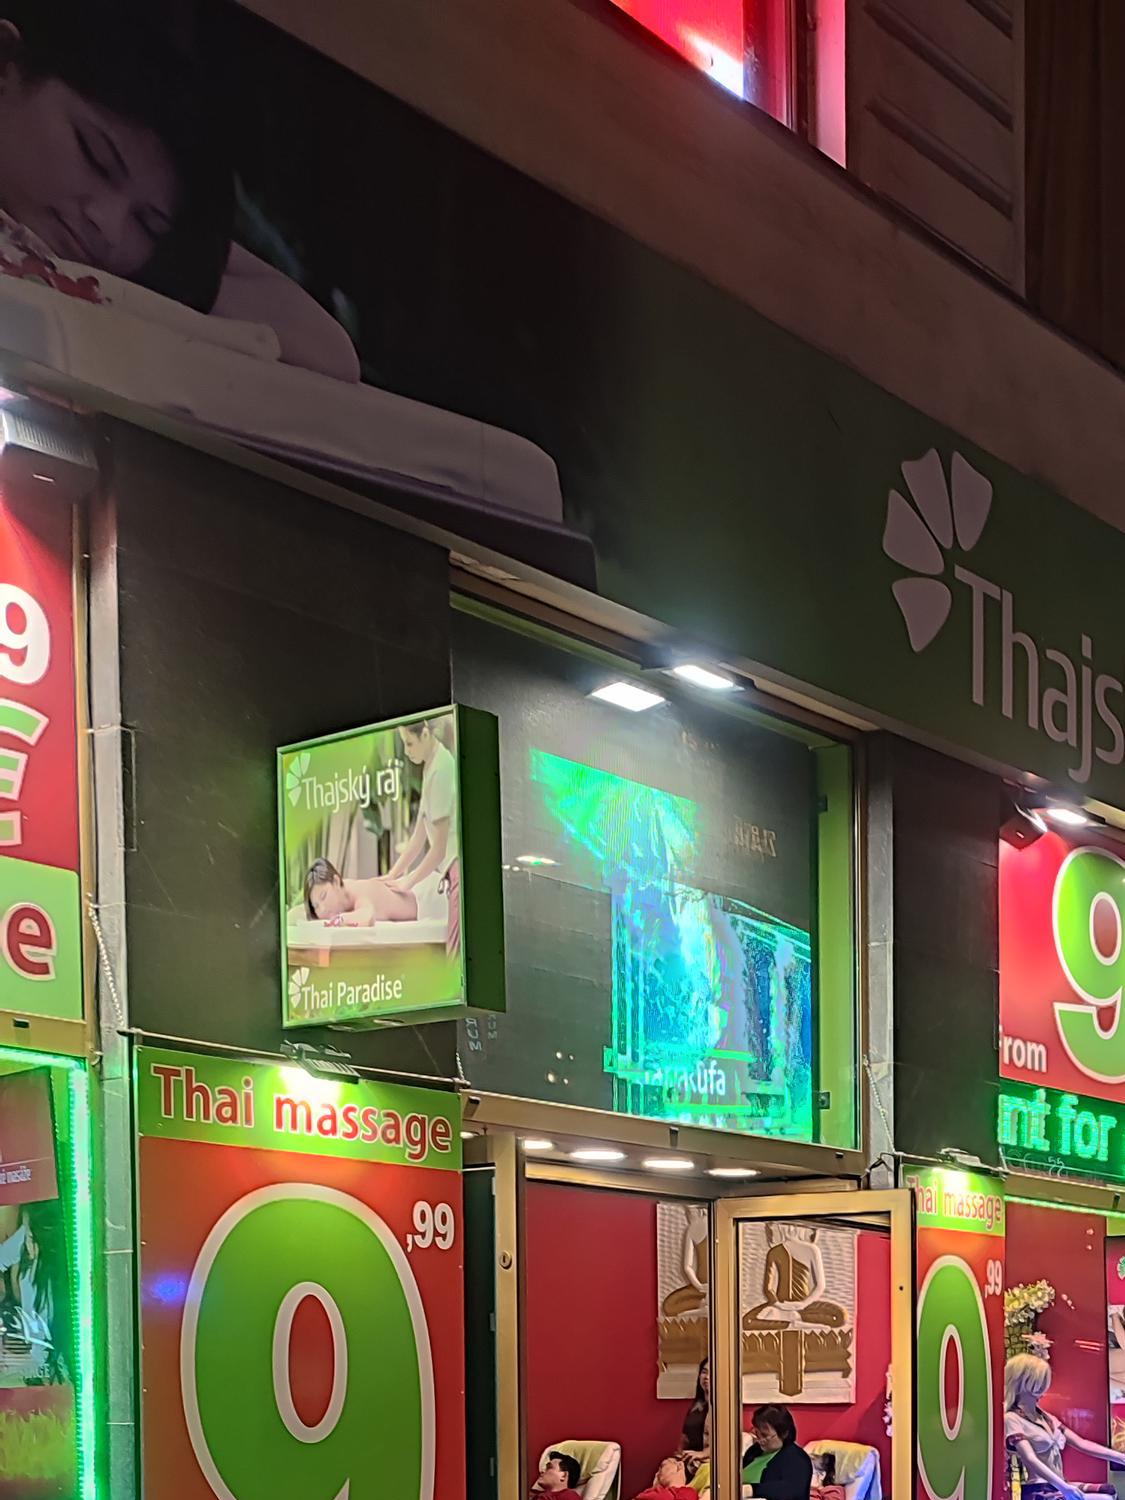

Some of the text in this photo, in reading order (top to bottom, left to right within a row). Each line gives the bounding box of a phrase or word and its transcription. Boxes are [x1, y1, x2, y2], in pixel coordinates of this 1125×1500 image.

[302, 759, 402, 813] Thajský ráj
[302, 974, 403, 1011] Thai Paradise
[999, 1025, 1047, 1073] rom
[150, 1062, 454, 1162] Thai massage
[1056, 1094, 1117, 1162] for
[943, 1190, 1004, 1231] massage
